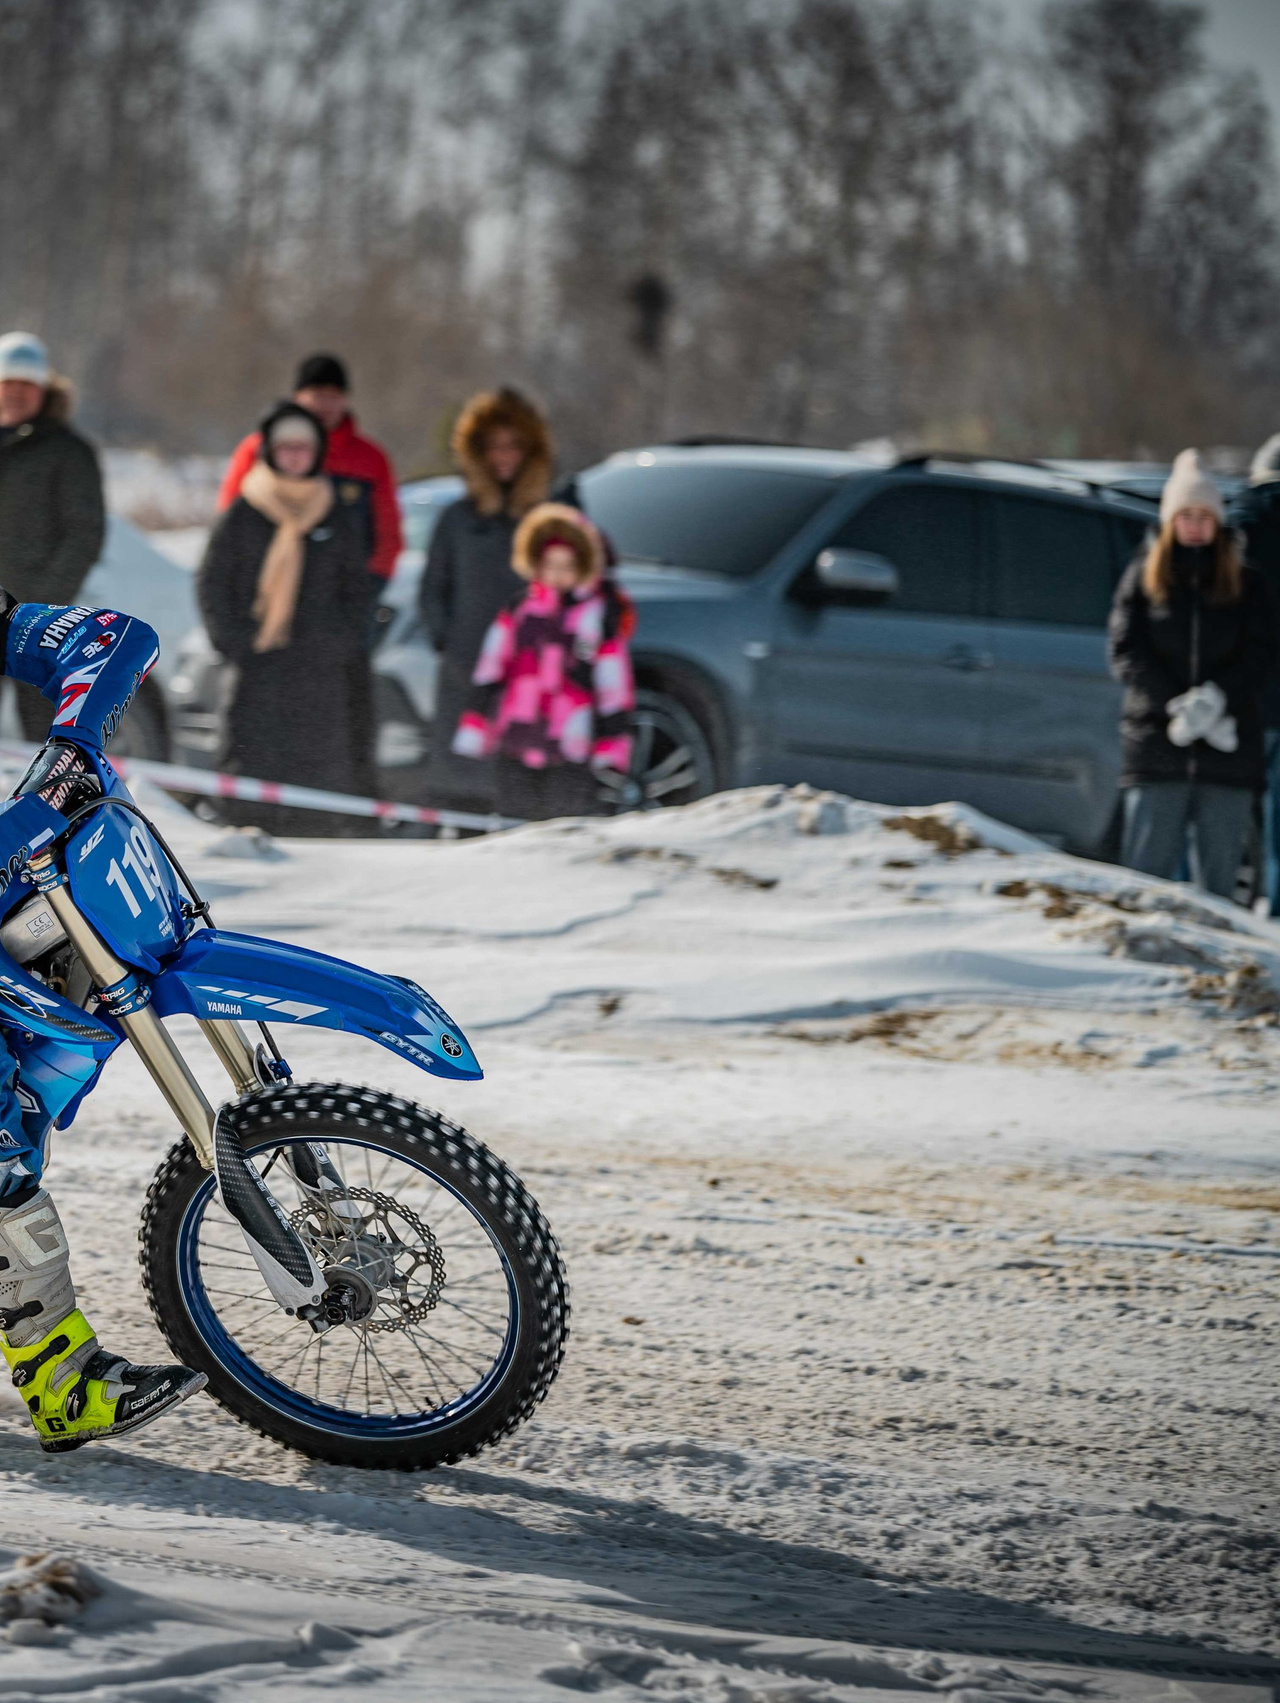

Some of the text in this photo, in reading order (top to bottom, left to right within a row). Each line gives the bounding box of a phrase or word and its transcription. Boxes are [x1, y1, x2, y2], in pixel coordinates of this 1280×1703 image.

[79, 824, 104, 863] YZ
[106, 825, 161, 919] 119
[207, 1001, 242, 1016] YAMAHA
